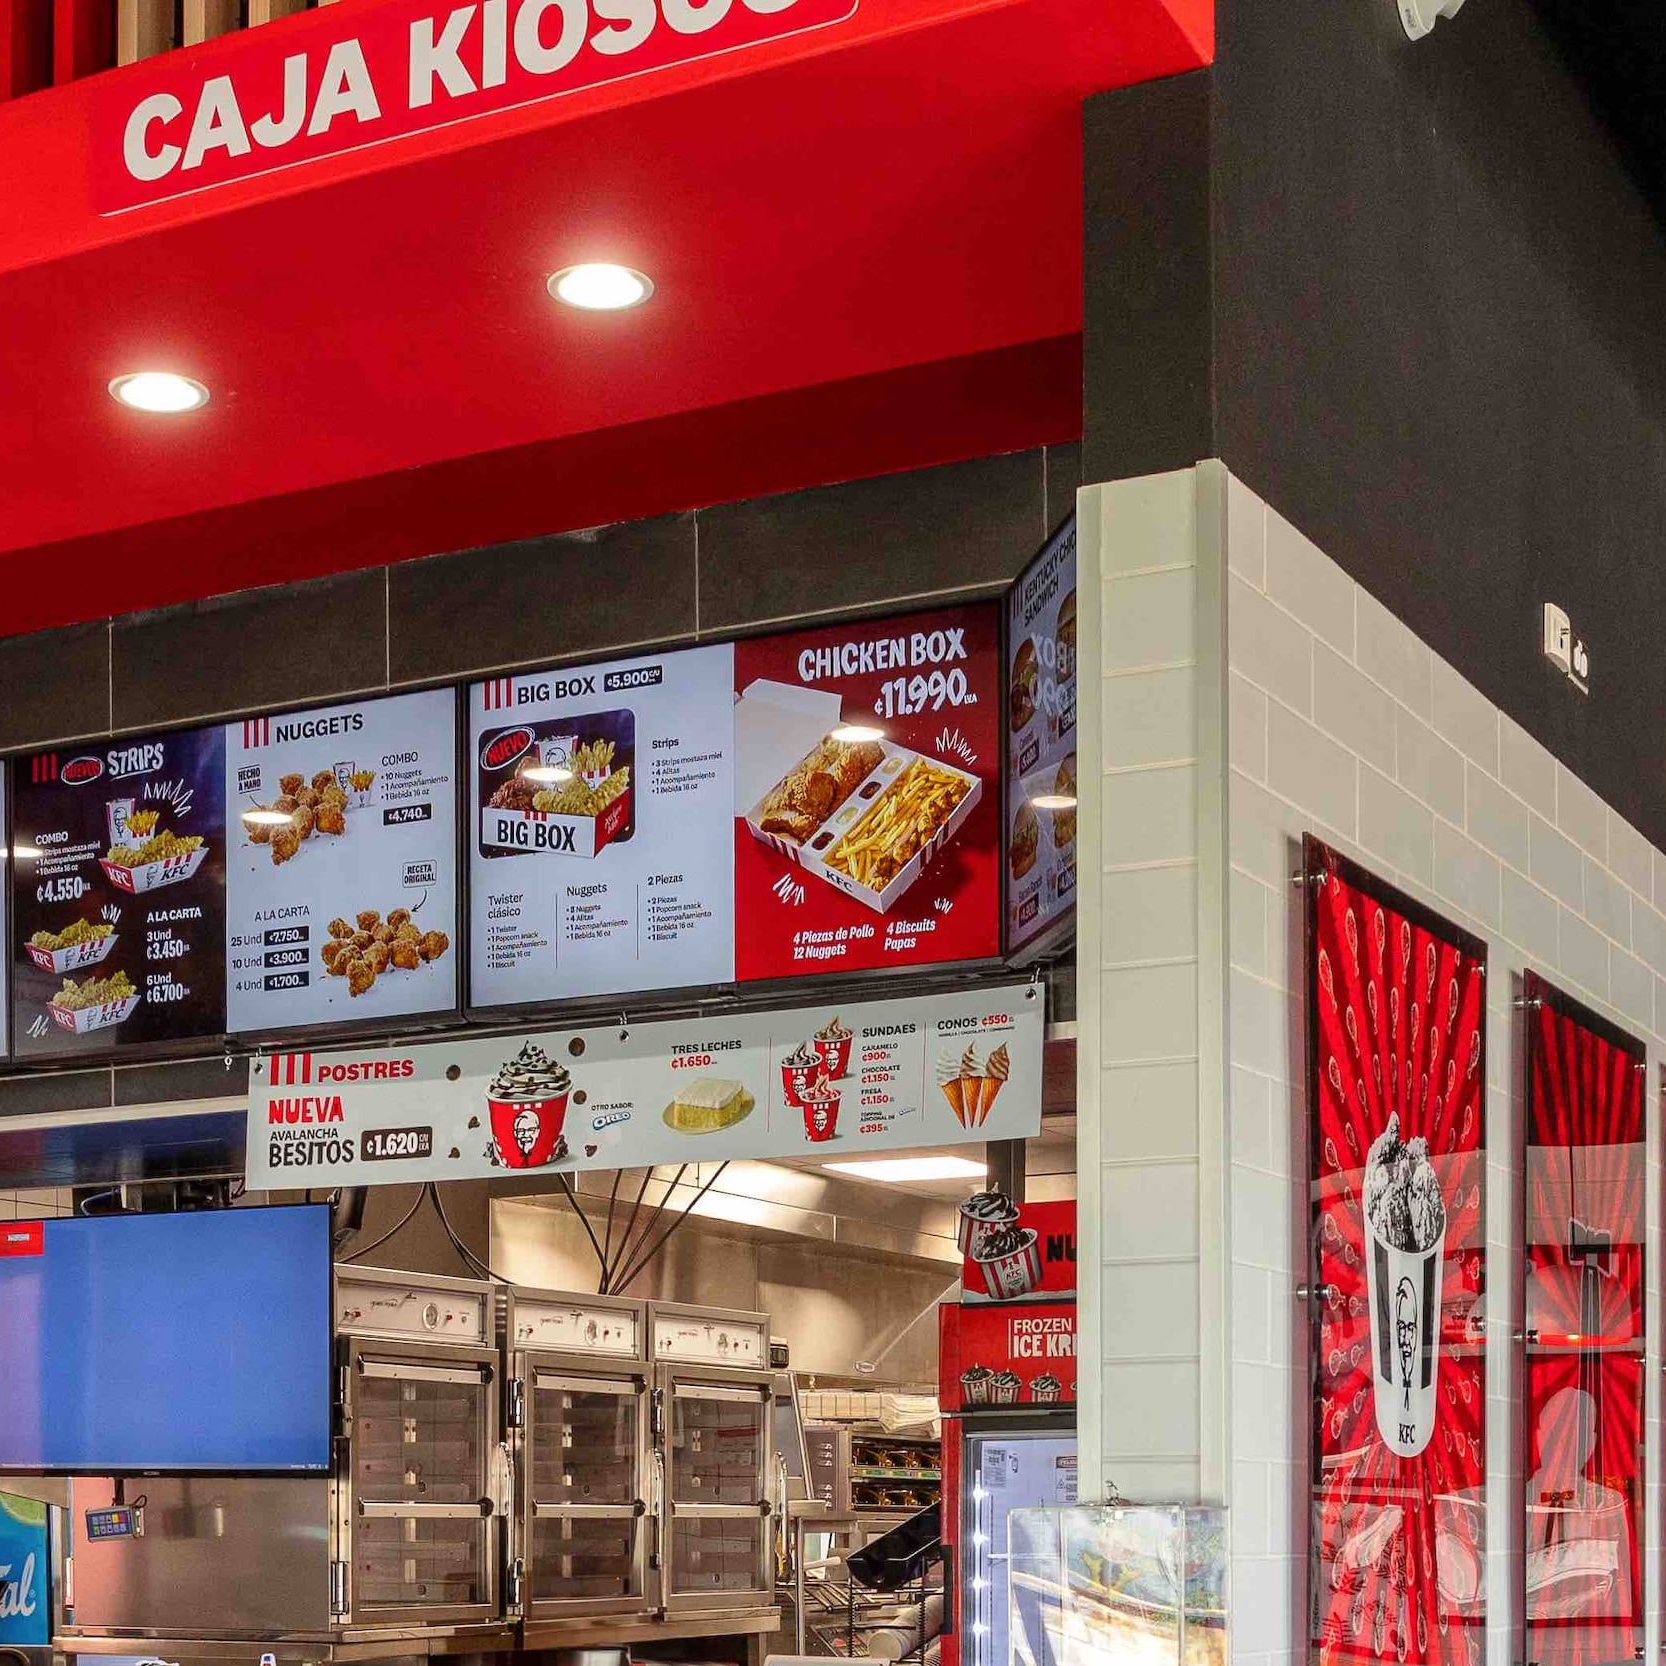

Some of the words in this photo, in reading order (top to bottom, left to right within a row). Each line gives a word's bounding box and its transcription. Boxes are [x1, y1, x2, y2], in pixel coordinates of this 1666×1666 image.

[122, 39, 382, 182] CAJA
[408, 0, 803, 109] KIOS
[1025, 554, 1059, 602] KENTUCKY
[1024, 573, 1059, 627] SANDWICH
[797, 637, 906, 682] CHICKEN
[910, 627, 968, 667] BOX
[517, 683, 550, 705] BIG
[555, 675, 596, 699] BOX
[276, 713, 363, 743] NUGGETS
[486, 729, 527, 766] NUEVO
[652, 737, 679, 750] Strips
[107, 743, 164, 775] STRIPS
[381, 752, 418, 766] COMBO
[238, 768, 261, 781] HECHO
[244, 778, 261, 790] MANO
[36, 832, 68, 845] COMBO
[497, 819, 528, 847] BIG
[535, 823, 576, 853] BOX
[648, 876, 654, 886] 2
[655, 873, 683, 885] Piezas
[825, 870, 854, 893] KFC
[566, 883, 608, 898] Nuggets
[488, 893, 524, 906] Twister
[147, 913, 154, 923] A
[155, 911, 168, 922] LA
[169, 907, 202, 920] CARTA
[255, 911, 262, 921] A
[264, 910, 276, 921] LA
[278, 905, 310, 919] CARTA
[488, 907, 521, 920] clásico
[154, 929, 171, 940] Und
[793, 932, 802, 944] 4
[802, 929, 834, 944] Piezas
[835, 928, 848, 940] de
[849, 924, 875, 939] Pollo
[886, 922, 895, 935] 4
[895, 918, 936, 935] Biscuits
[231, 936, 242, 947] 25
[244, 933, 262, 946] Und
[884, 937, 916, 951] Papas
[793, 947, 804, 960] 12
[805, 943, 847, 960] Nuggets
[232, 959, 242, 969] 10
[244, 956, 262, 968] Und
[154, 972, 171, 984] Und
[236, 981, 242, 991] 4
[244, 978, 262, 991] Und
[862, 1024, 916, 1038] SUNDAES
[937, 1017, 978, 1031] CONOS
[671, 1044, 699, 1055] TRES
[702, 1040, 742, 1052] LECHES
[862, 1043, 898, 1051] CARAMELO
[318, 1059, 414, 1083] POSTRES
[862, 1065, 900, 1073] CHOCOLATE
[269, 1096, 344, 1125] NUEVA
[592, 1111, 632, 1130] OREO
[270, 1127, 339, 1142] AVALANCHA
[269, 1140, 354, 1168] BESITOS
[1013, 1317, 1072, 1334] FROZEN
[1013, 1334, 1043, 1358] ICE
[1399, 1423, 1415, 1444] KFC
